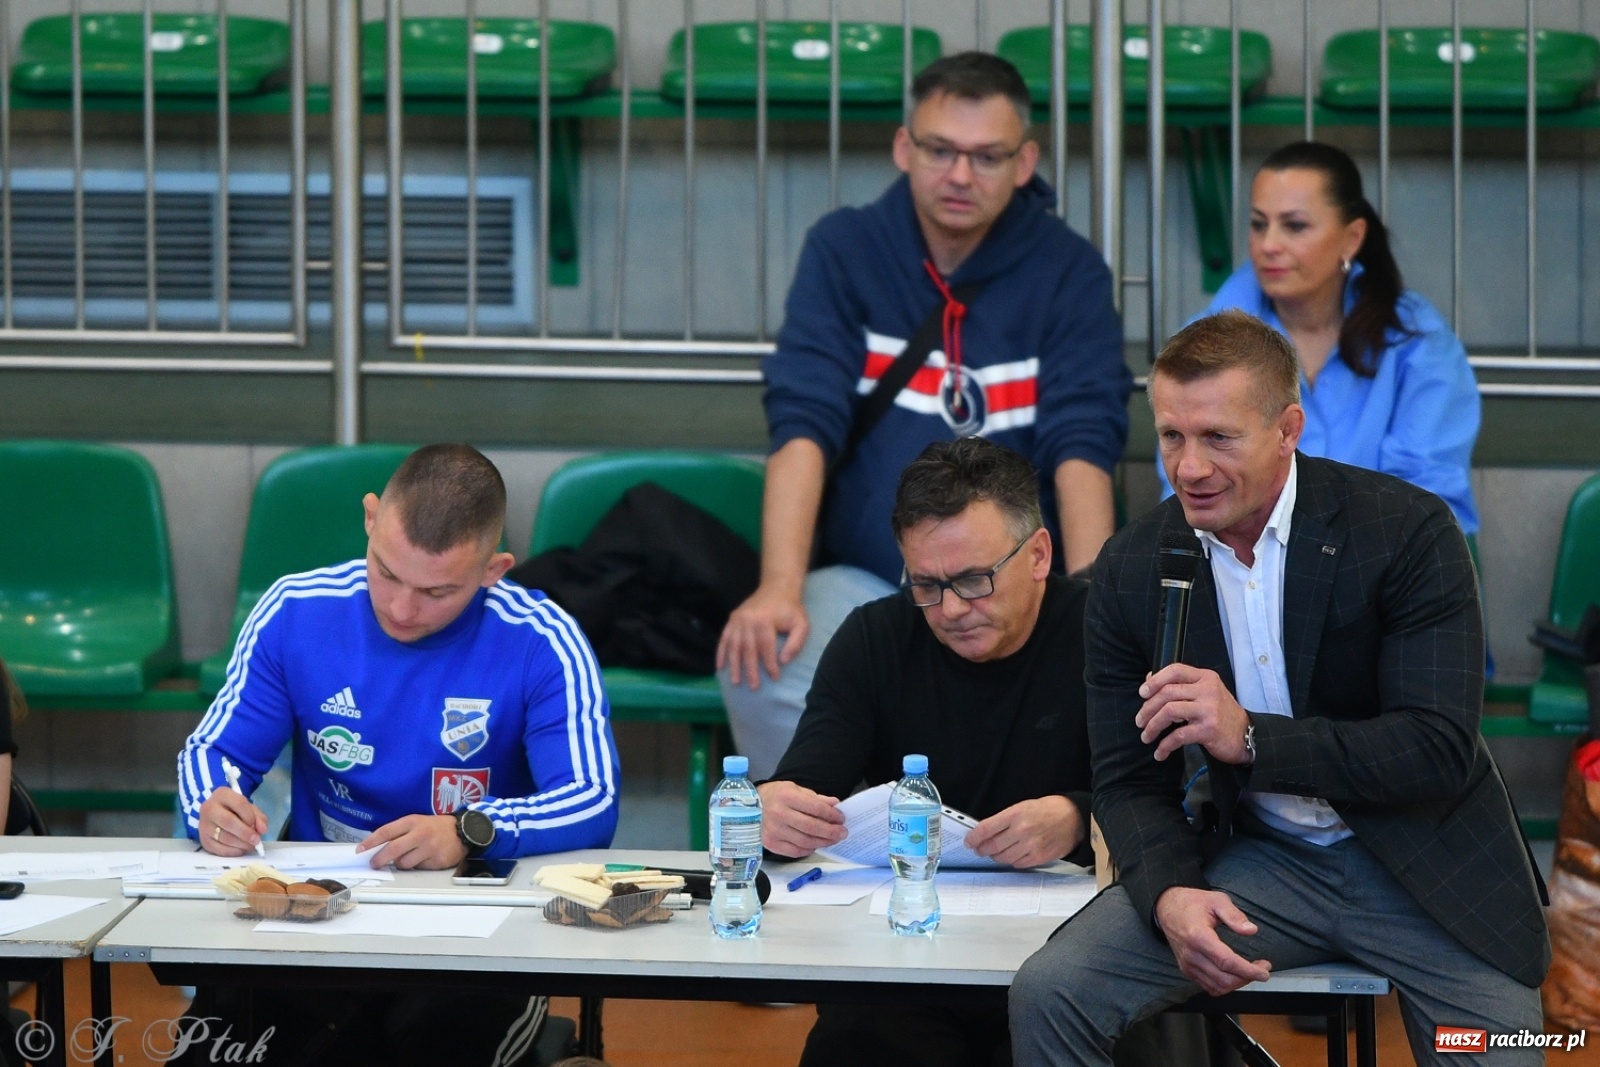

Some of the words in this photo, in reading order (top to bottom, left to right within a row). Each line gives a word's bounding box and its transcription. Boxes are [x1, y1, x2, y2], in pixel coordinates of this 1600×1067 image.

[320, 702, 362, 719] adidas
[448, 723, 480, 741] UNIA
[328, 778, 354, 802] VR
